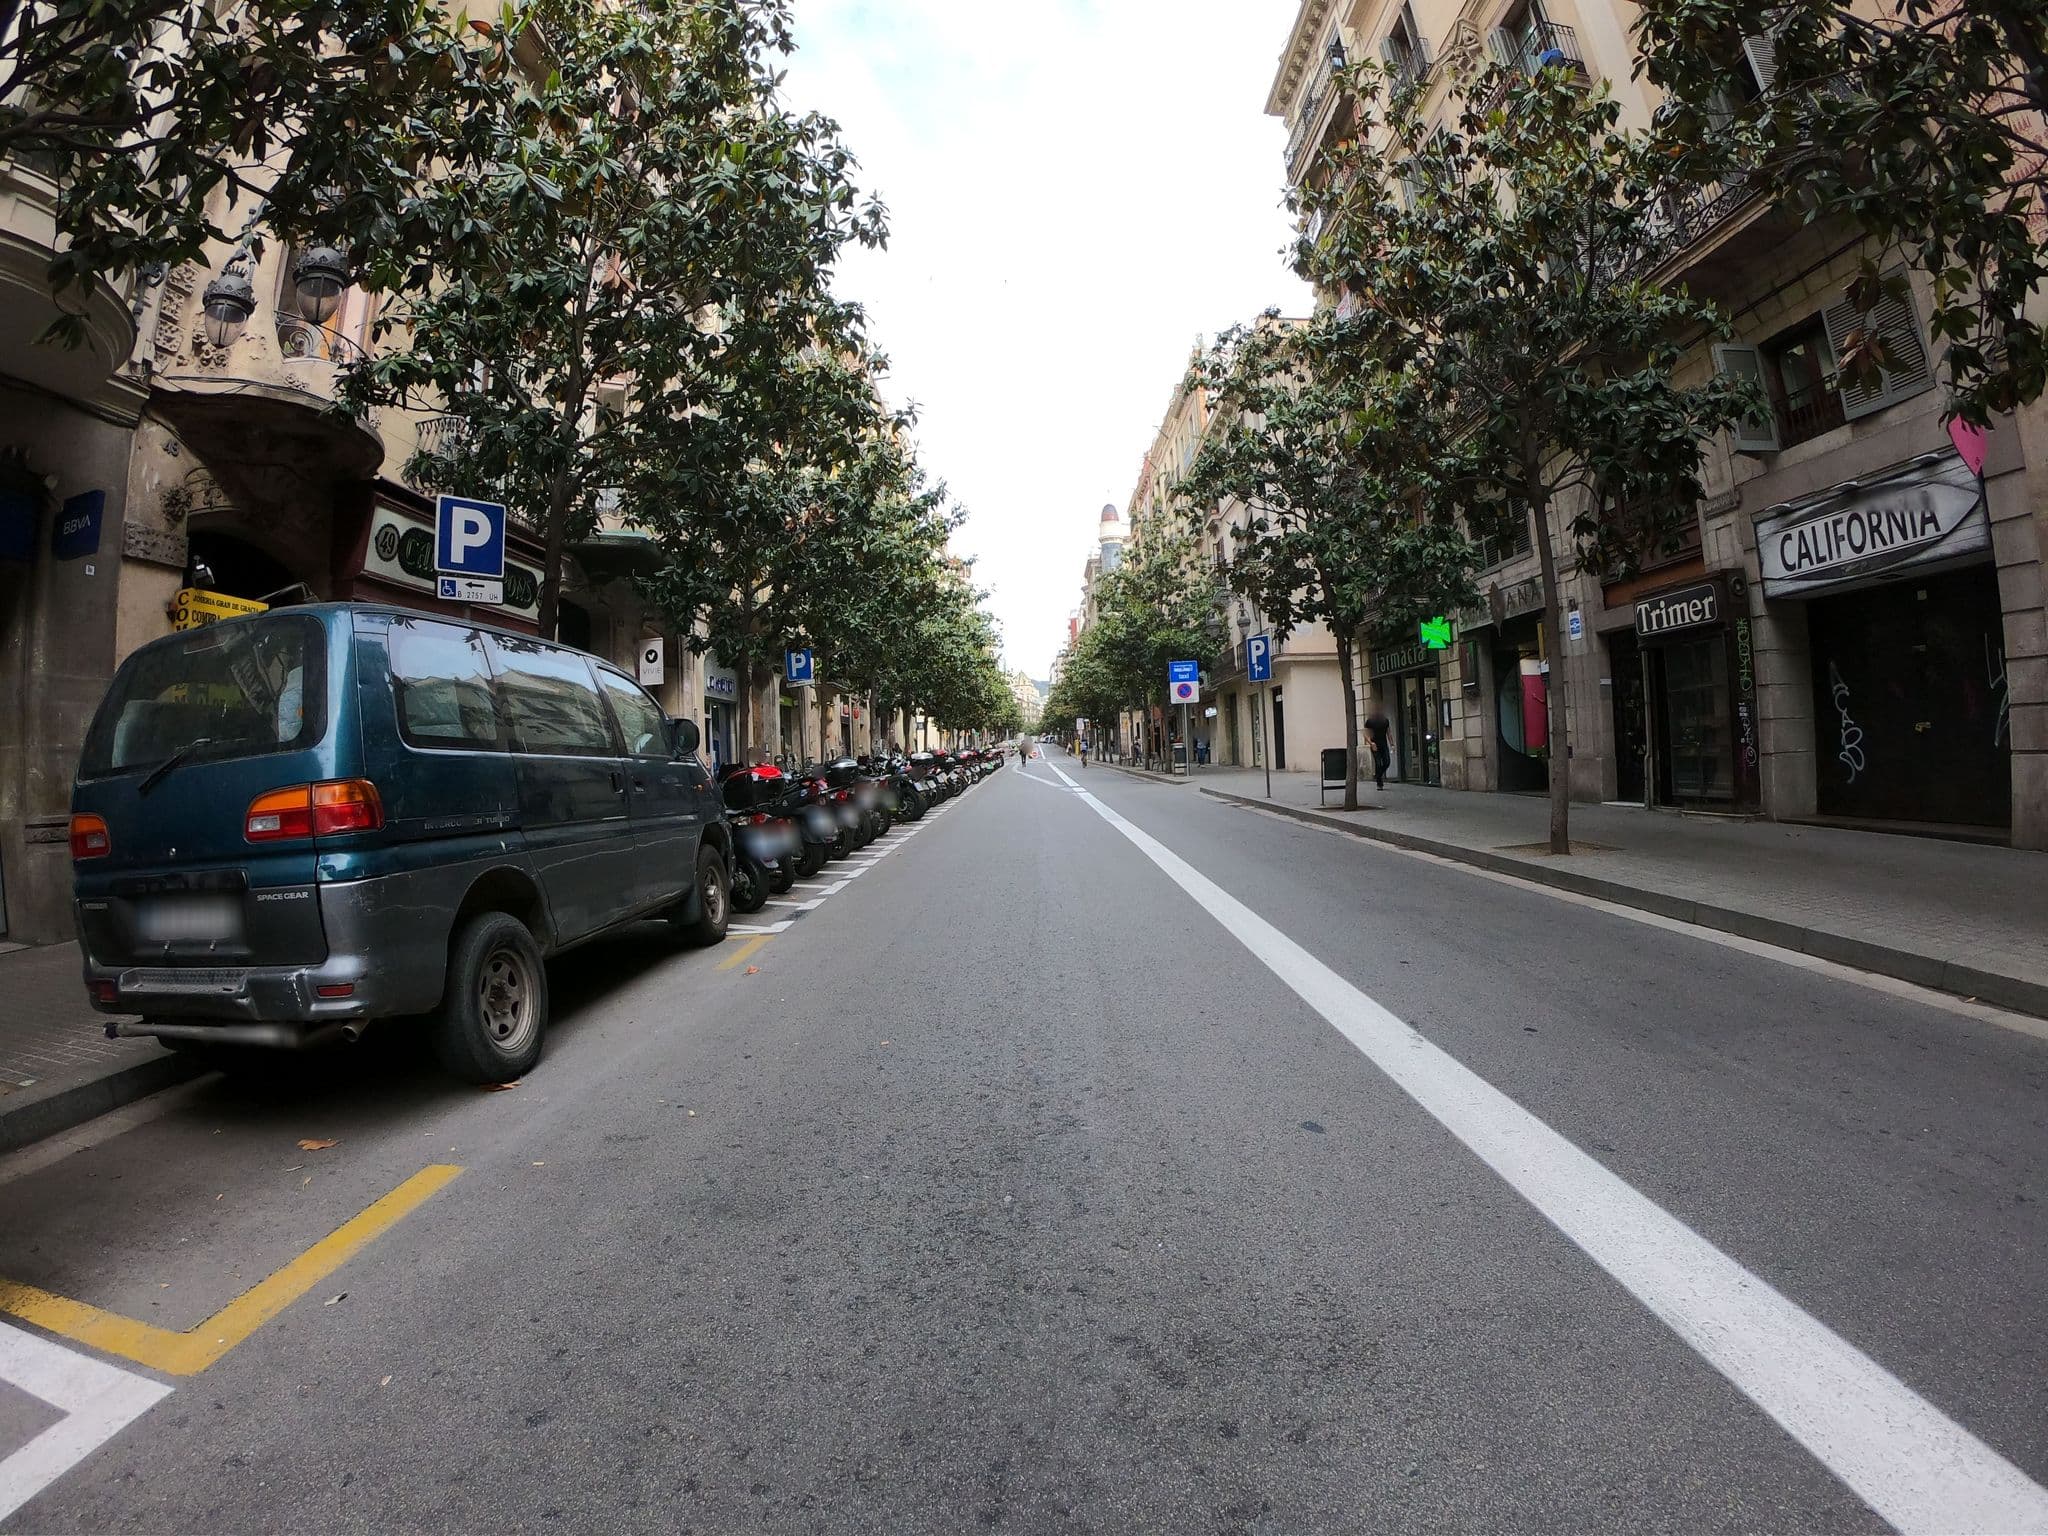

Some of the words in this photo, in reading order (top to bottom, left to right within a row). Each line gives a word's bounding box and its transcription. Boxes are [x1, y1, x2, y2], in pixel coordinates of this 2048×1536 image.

[63, 514, 91, 535] BBVA
[451, 506, 492, 564] P
[1780, 494, 1941, 572] CALIFORNIA
[1636, 595, 1714, 633] Trimer
[790, 652, 806, 677] P
[1250, 639, 1266, 665] P
[257, 893, 283, 901] SPACE
[283, 891, 309, 899] GEAR
